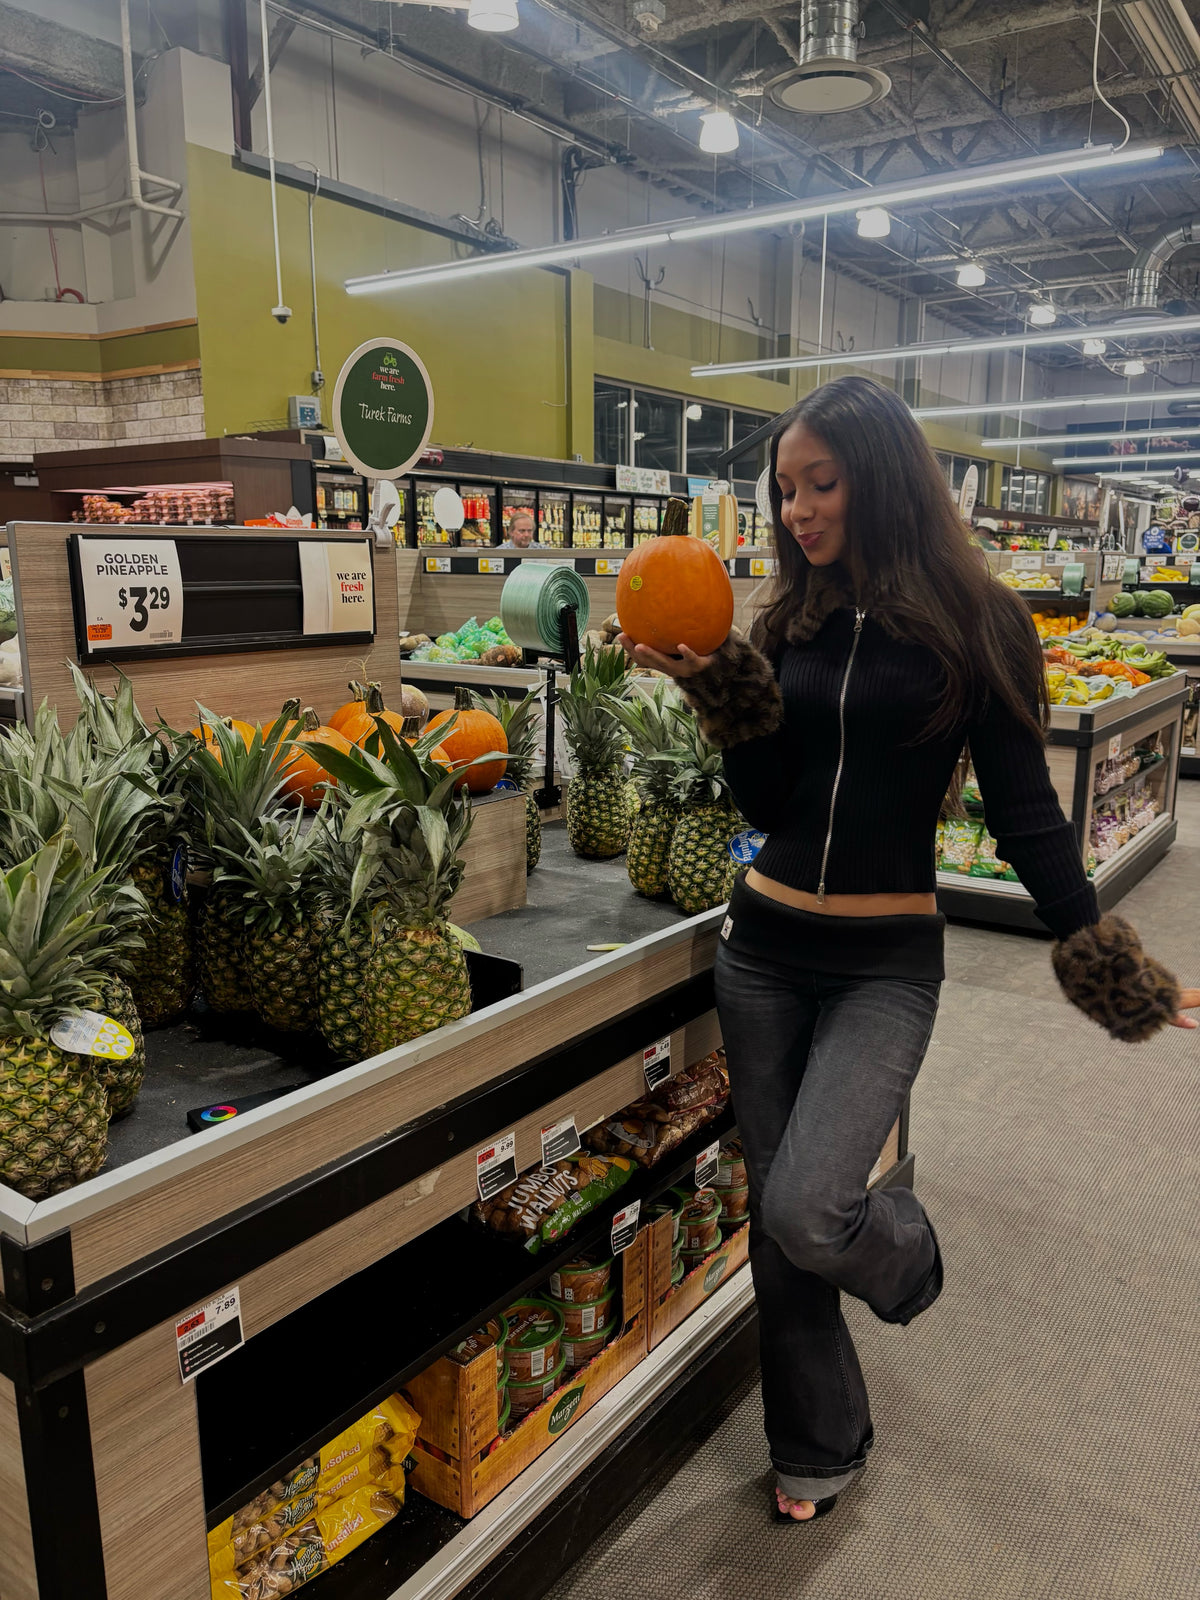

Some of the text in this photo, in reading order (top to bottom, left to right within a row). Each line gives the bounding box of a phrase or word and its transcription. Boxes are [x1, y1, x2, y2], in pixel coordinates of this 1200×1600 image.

[389, 367, 399, 375] are
[372, 372, 405, 384] farm fresh
[380, 381, 396, 391] here.
[359, 402, 413, 425] Turek Farms
[104, 553, 159, 564] GOLDEN
[96, 565, 169, 576] PINEAPPLE
[336, 572, 367, 580] we are
[340, 581, 364, 592] fresh
[342, 593, 365, 603] here.
[500, 1140, 514, 1153] 9.99
[507, 1166, 558, 1215] JUMBO
[519, 1169, 579, 1231] WALNUTS
[215, 1297, 236, 1315] 7.89
[528, 1313, 540, 1324] dip
[550, 1391, 581, 1427] Marzetti
[288, 1540, 324, 1580] Hampton
[303, 1550, 322, 1581] Farms
